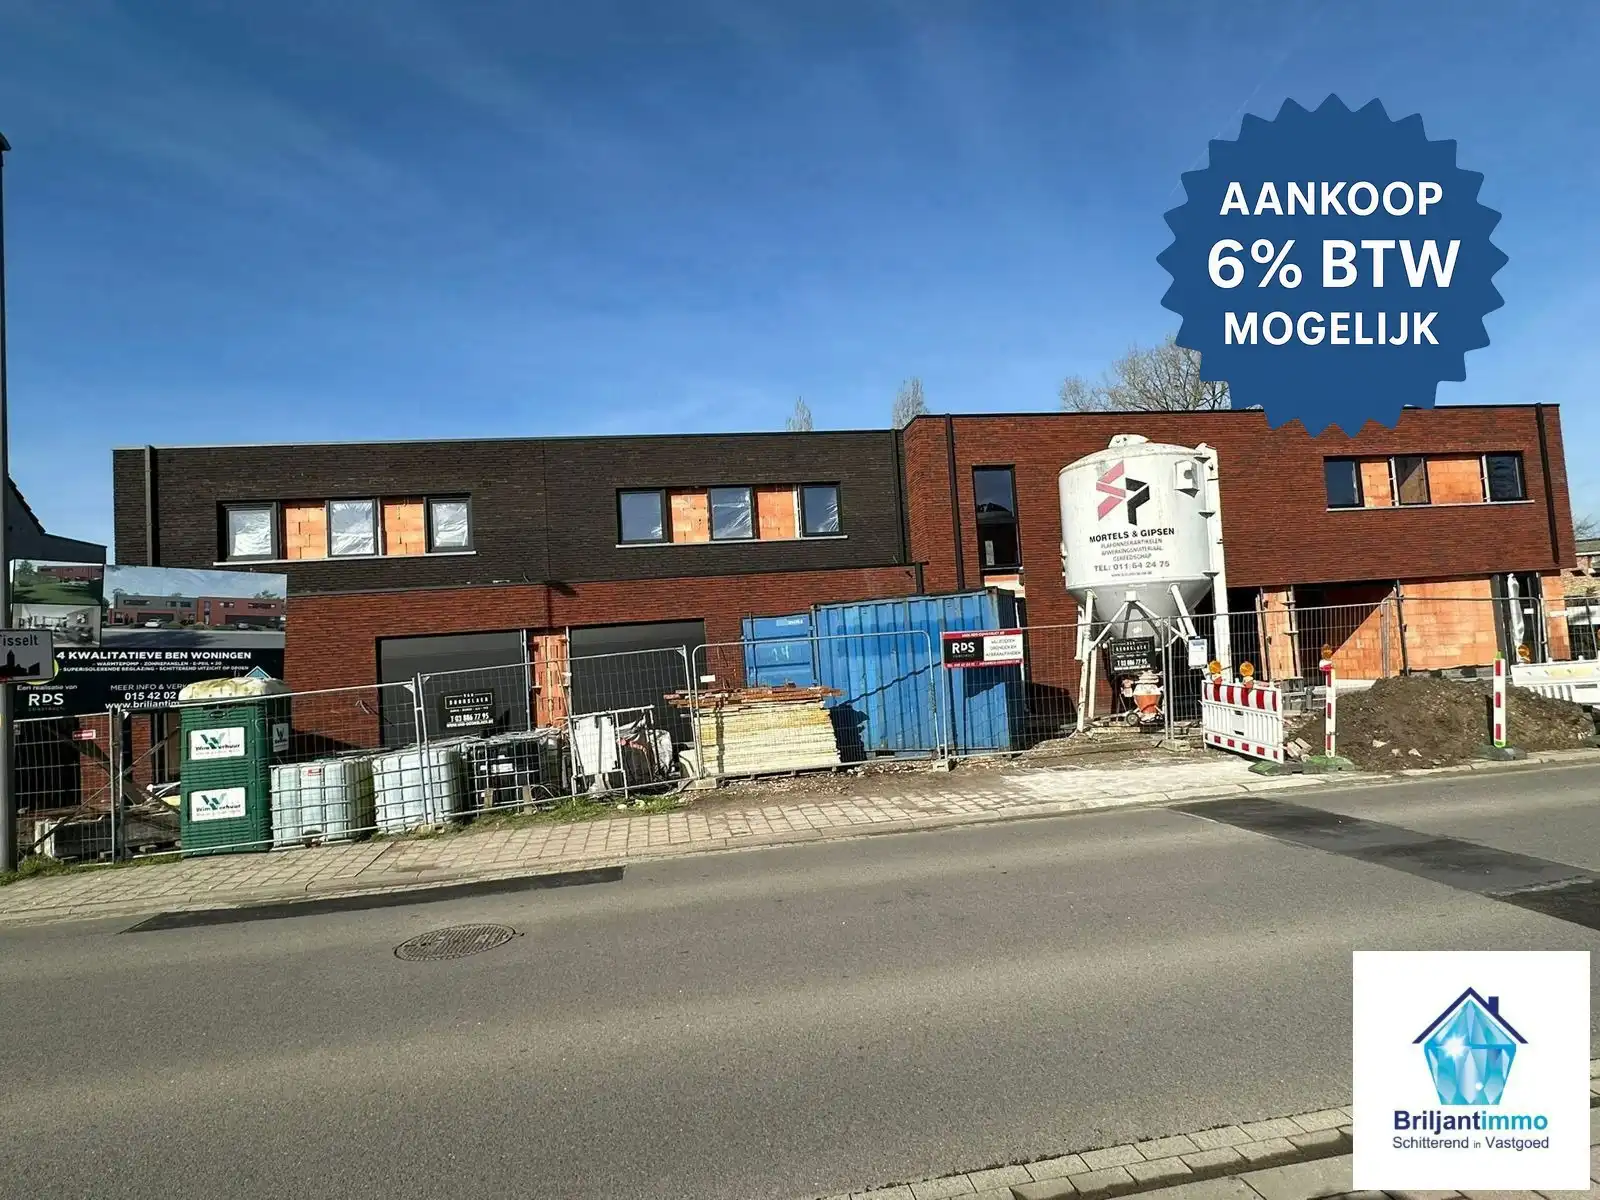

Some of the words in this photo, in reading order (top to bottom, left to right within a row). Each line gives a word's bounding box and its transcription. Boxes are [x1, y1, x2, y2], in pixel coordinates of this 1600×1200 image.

[1089, 530, 1129, 543] MORTELS
[1132, 530, 1138, 538] &
[1140, 527, 1175, 537] GIPSEN
[1145, 560, 1157, 568] 24
[952, 641, 975, 654] RDS
[56, 651, 65, 660] 4
[68, 651, 162, 660] KWALITATIEVE
[165, 652, 188, 660] BEN
[191, 652, 252, 660] WONINGEN
[29, 693, 64, 706] RDS
[124, 691, 145, 700] 015
[147, 691, 160, 700] 42
[163, 691, 177, 699] 02
